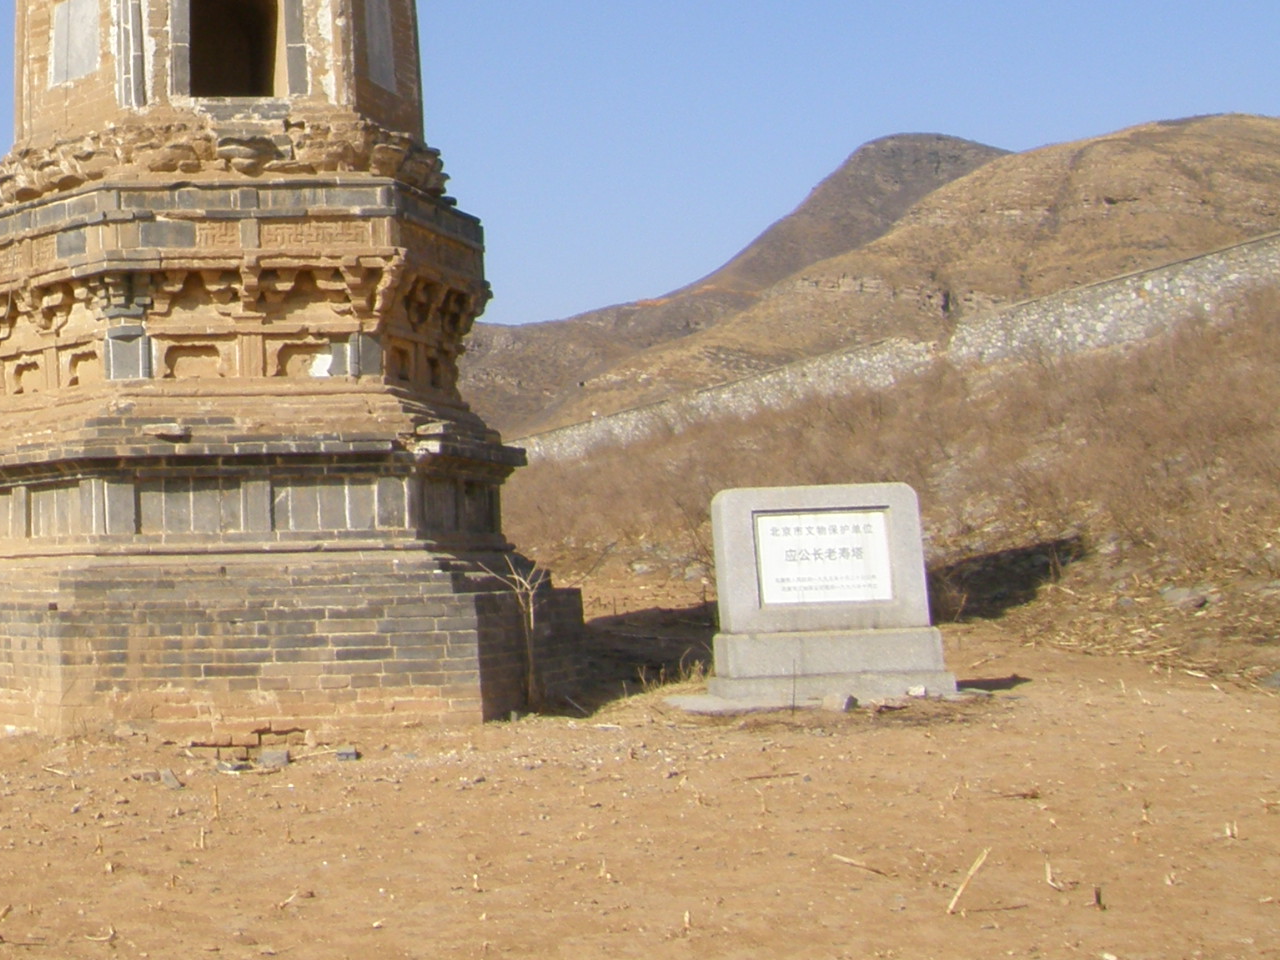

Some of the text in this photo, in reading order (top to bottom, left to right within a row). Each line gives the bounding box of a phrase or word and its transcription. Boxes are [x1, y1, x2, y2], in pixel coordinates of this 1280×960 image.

[769, 523, 873, 537] 北京市文物保护单位
[785, 547, 864, 562] 应公长老寿塔
